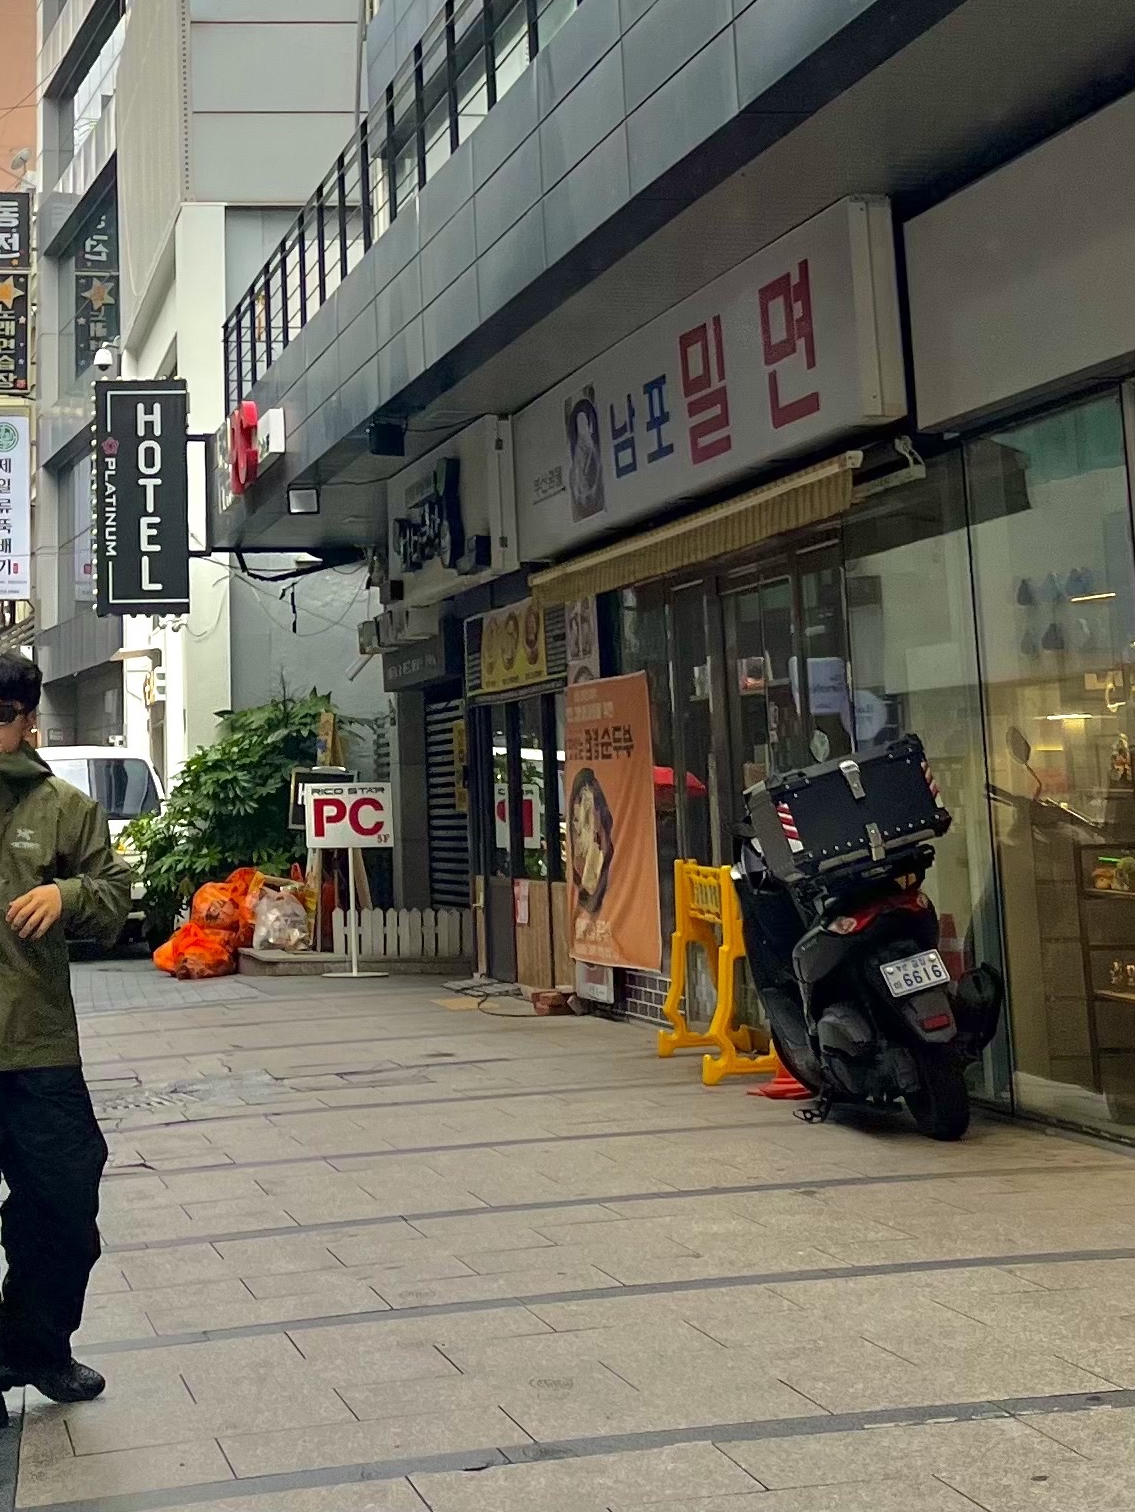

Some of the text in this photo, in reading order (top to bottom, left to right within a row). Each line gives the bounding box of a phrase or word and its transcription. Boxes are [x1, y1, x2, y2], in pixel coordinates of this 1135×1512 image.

[609, 258, 820, 480] 남포 밀면
[104, 457, 117, 556] PLATINUM
[136, 402, 163, 591] HOTEL
[313, 797, 385, 837] PC
[347, 787, 386, 795] STAR
[377, 834, 390, 843] 5F
